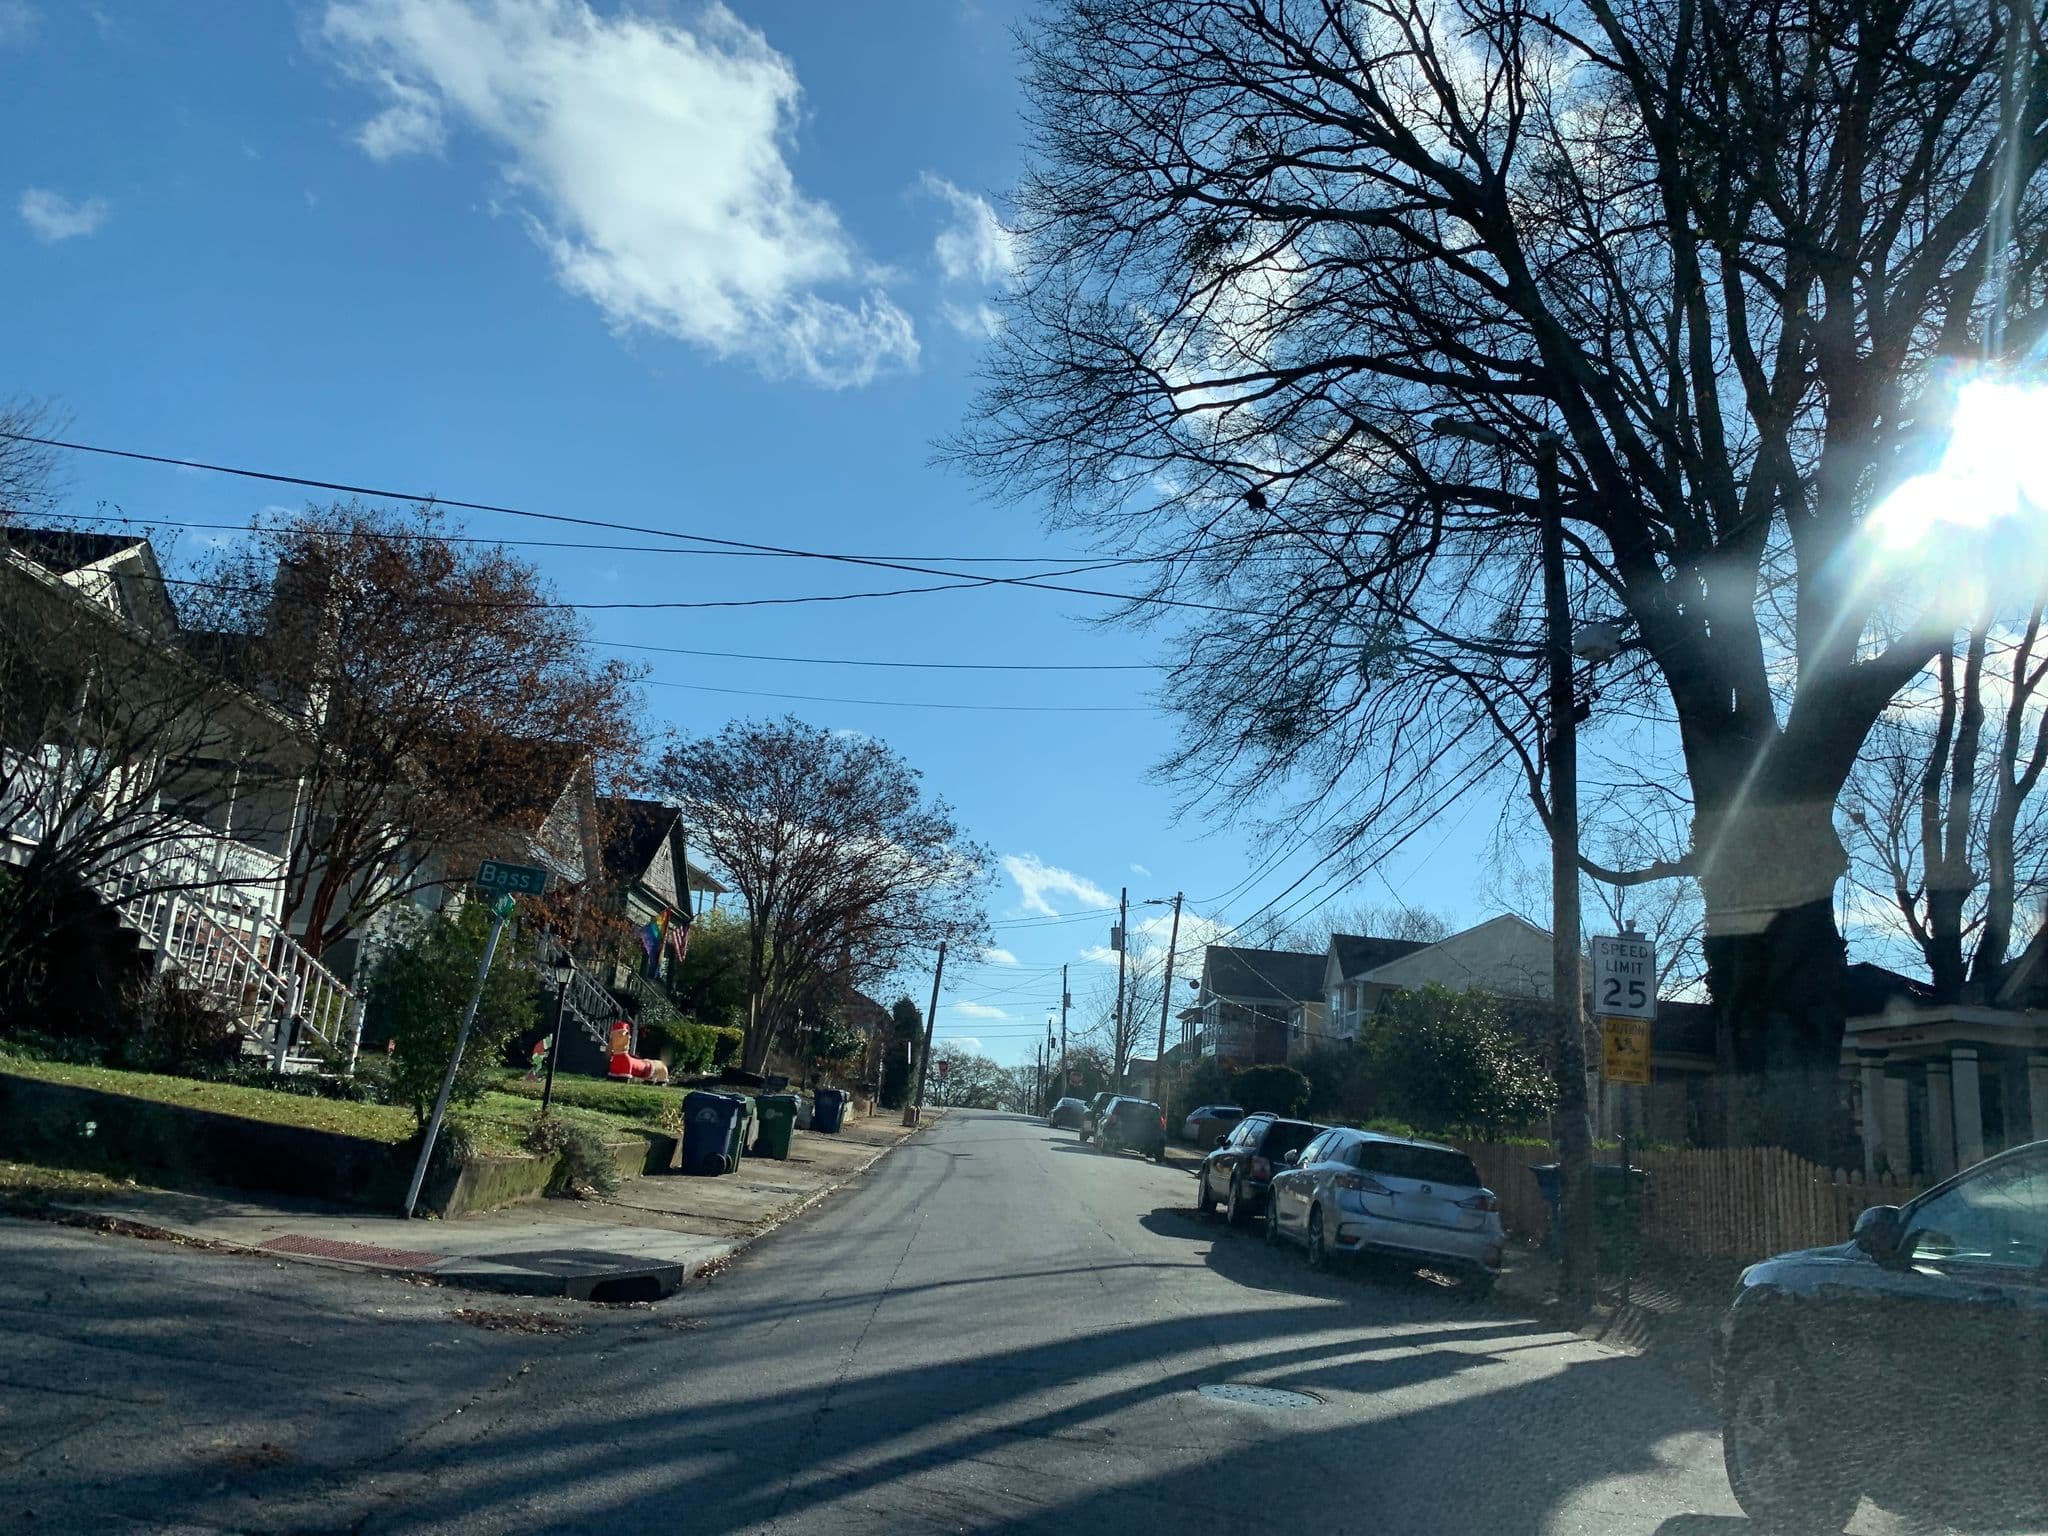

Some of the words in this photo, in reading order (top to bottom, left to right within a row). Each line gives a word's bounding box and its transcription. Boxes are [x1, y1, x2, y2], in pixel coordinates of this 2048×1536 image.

[481, 864, 530, 888] Bass
[1601, 943, 1648, 958] SPEED
[1606, 960, 1643, 974] LIMIT
[1603, 978, 1646, 1008] 25
